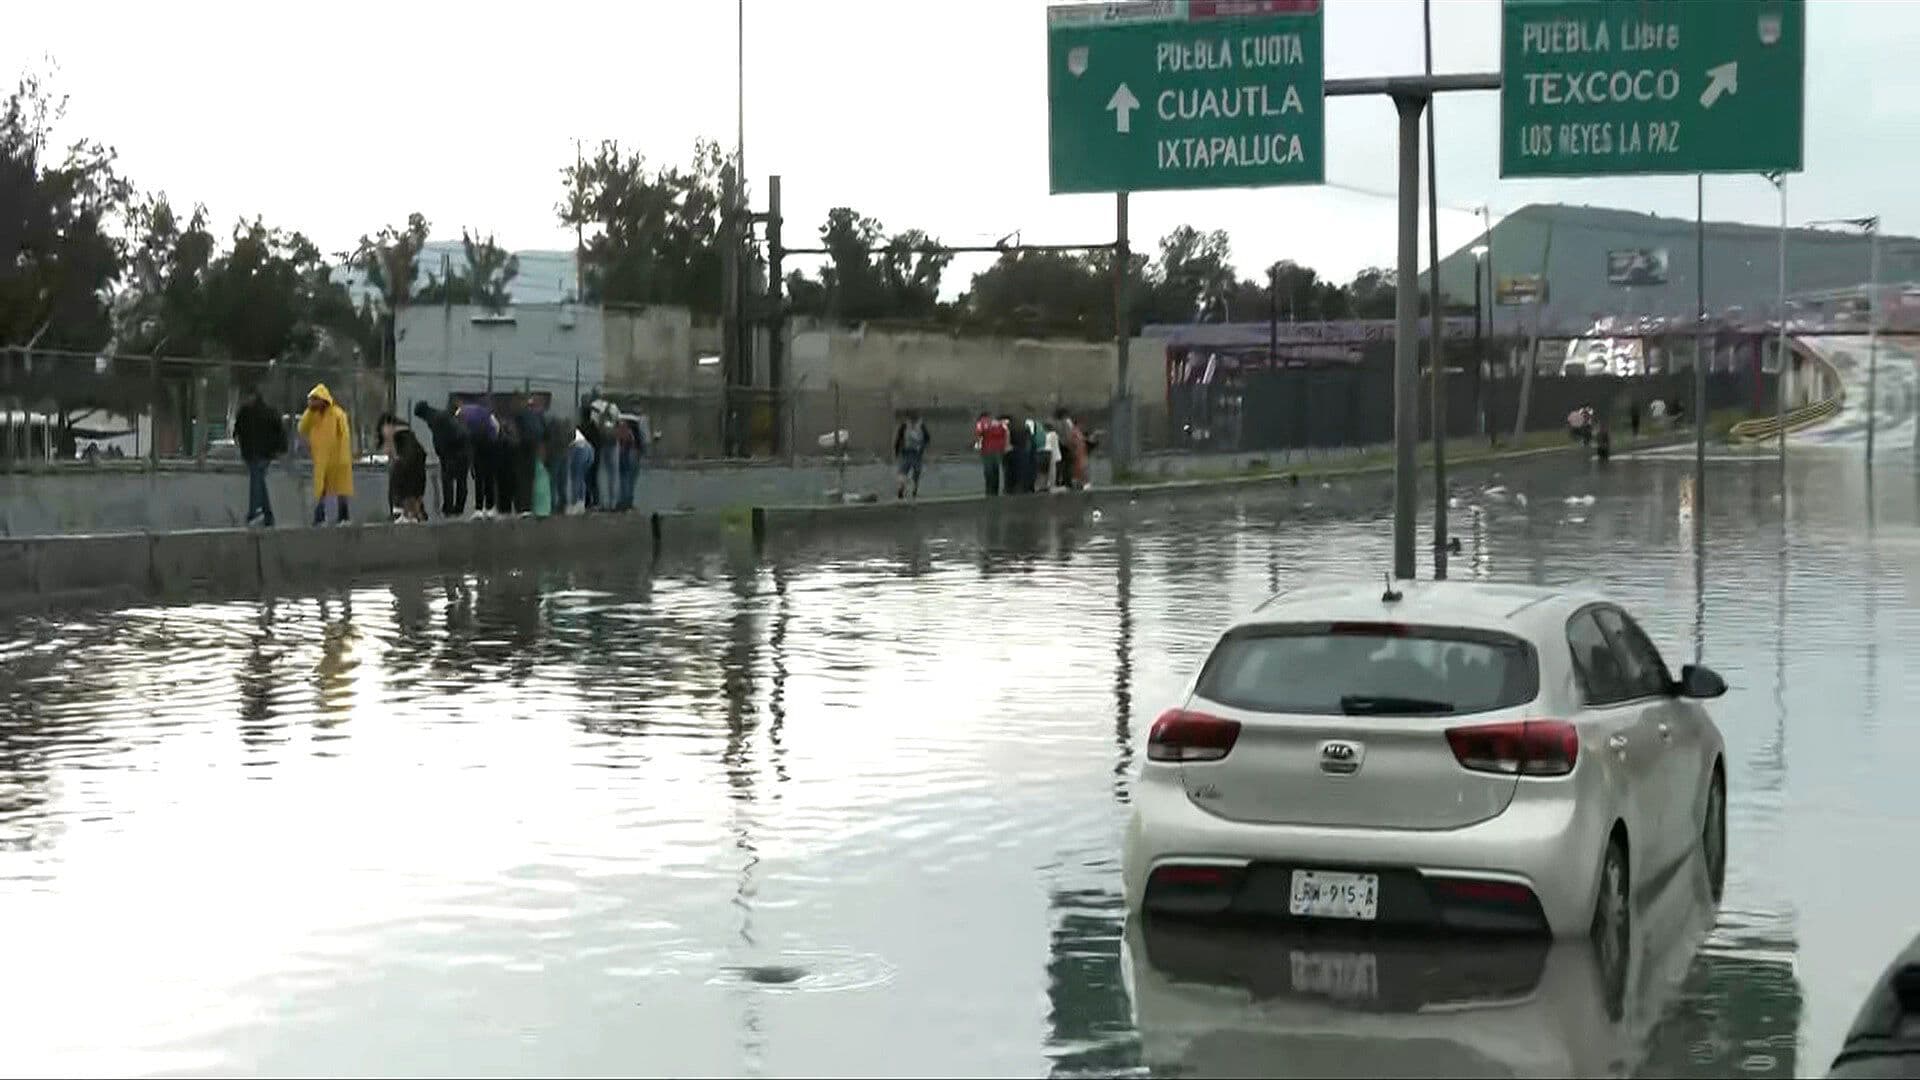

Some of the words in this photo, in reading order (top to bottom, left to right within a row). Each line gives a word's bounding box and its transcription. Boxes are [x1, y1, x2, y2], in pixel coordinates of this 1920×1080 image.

[1157, 38, 1232, 73] PUEBLA
[1243, 34, 1303, 67] CUOTA
[1523, 20, 1611, 53] PUEBLA
[1158, 85, 1303, 121] CUAUTLA
[1523, 70, 1680, 105] TEXCOCO
[1157, 135, 1304, 169] IXTAPALUCA
[1521, 125, 1552, 155] LOS
[1560, 122, 1611, 154] REYES
[1620, 121, 1640, 153] LA
[1649, 122, 1680, 152] PAZ
